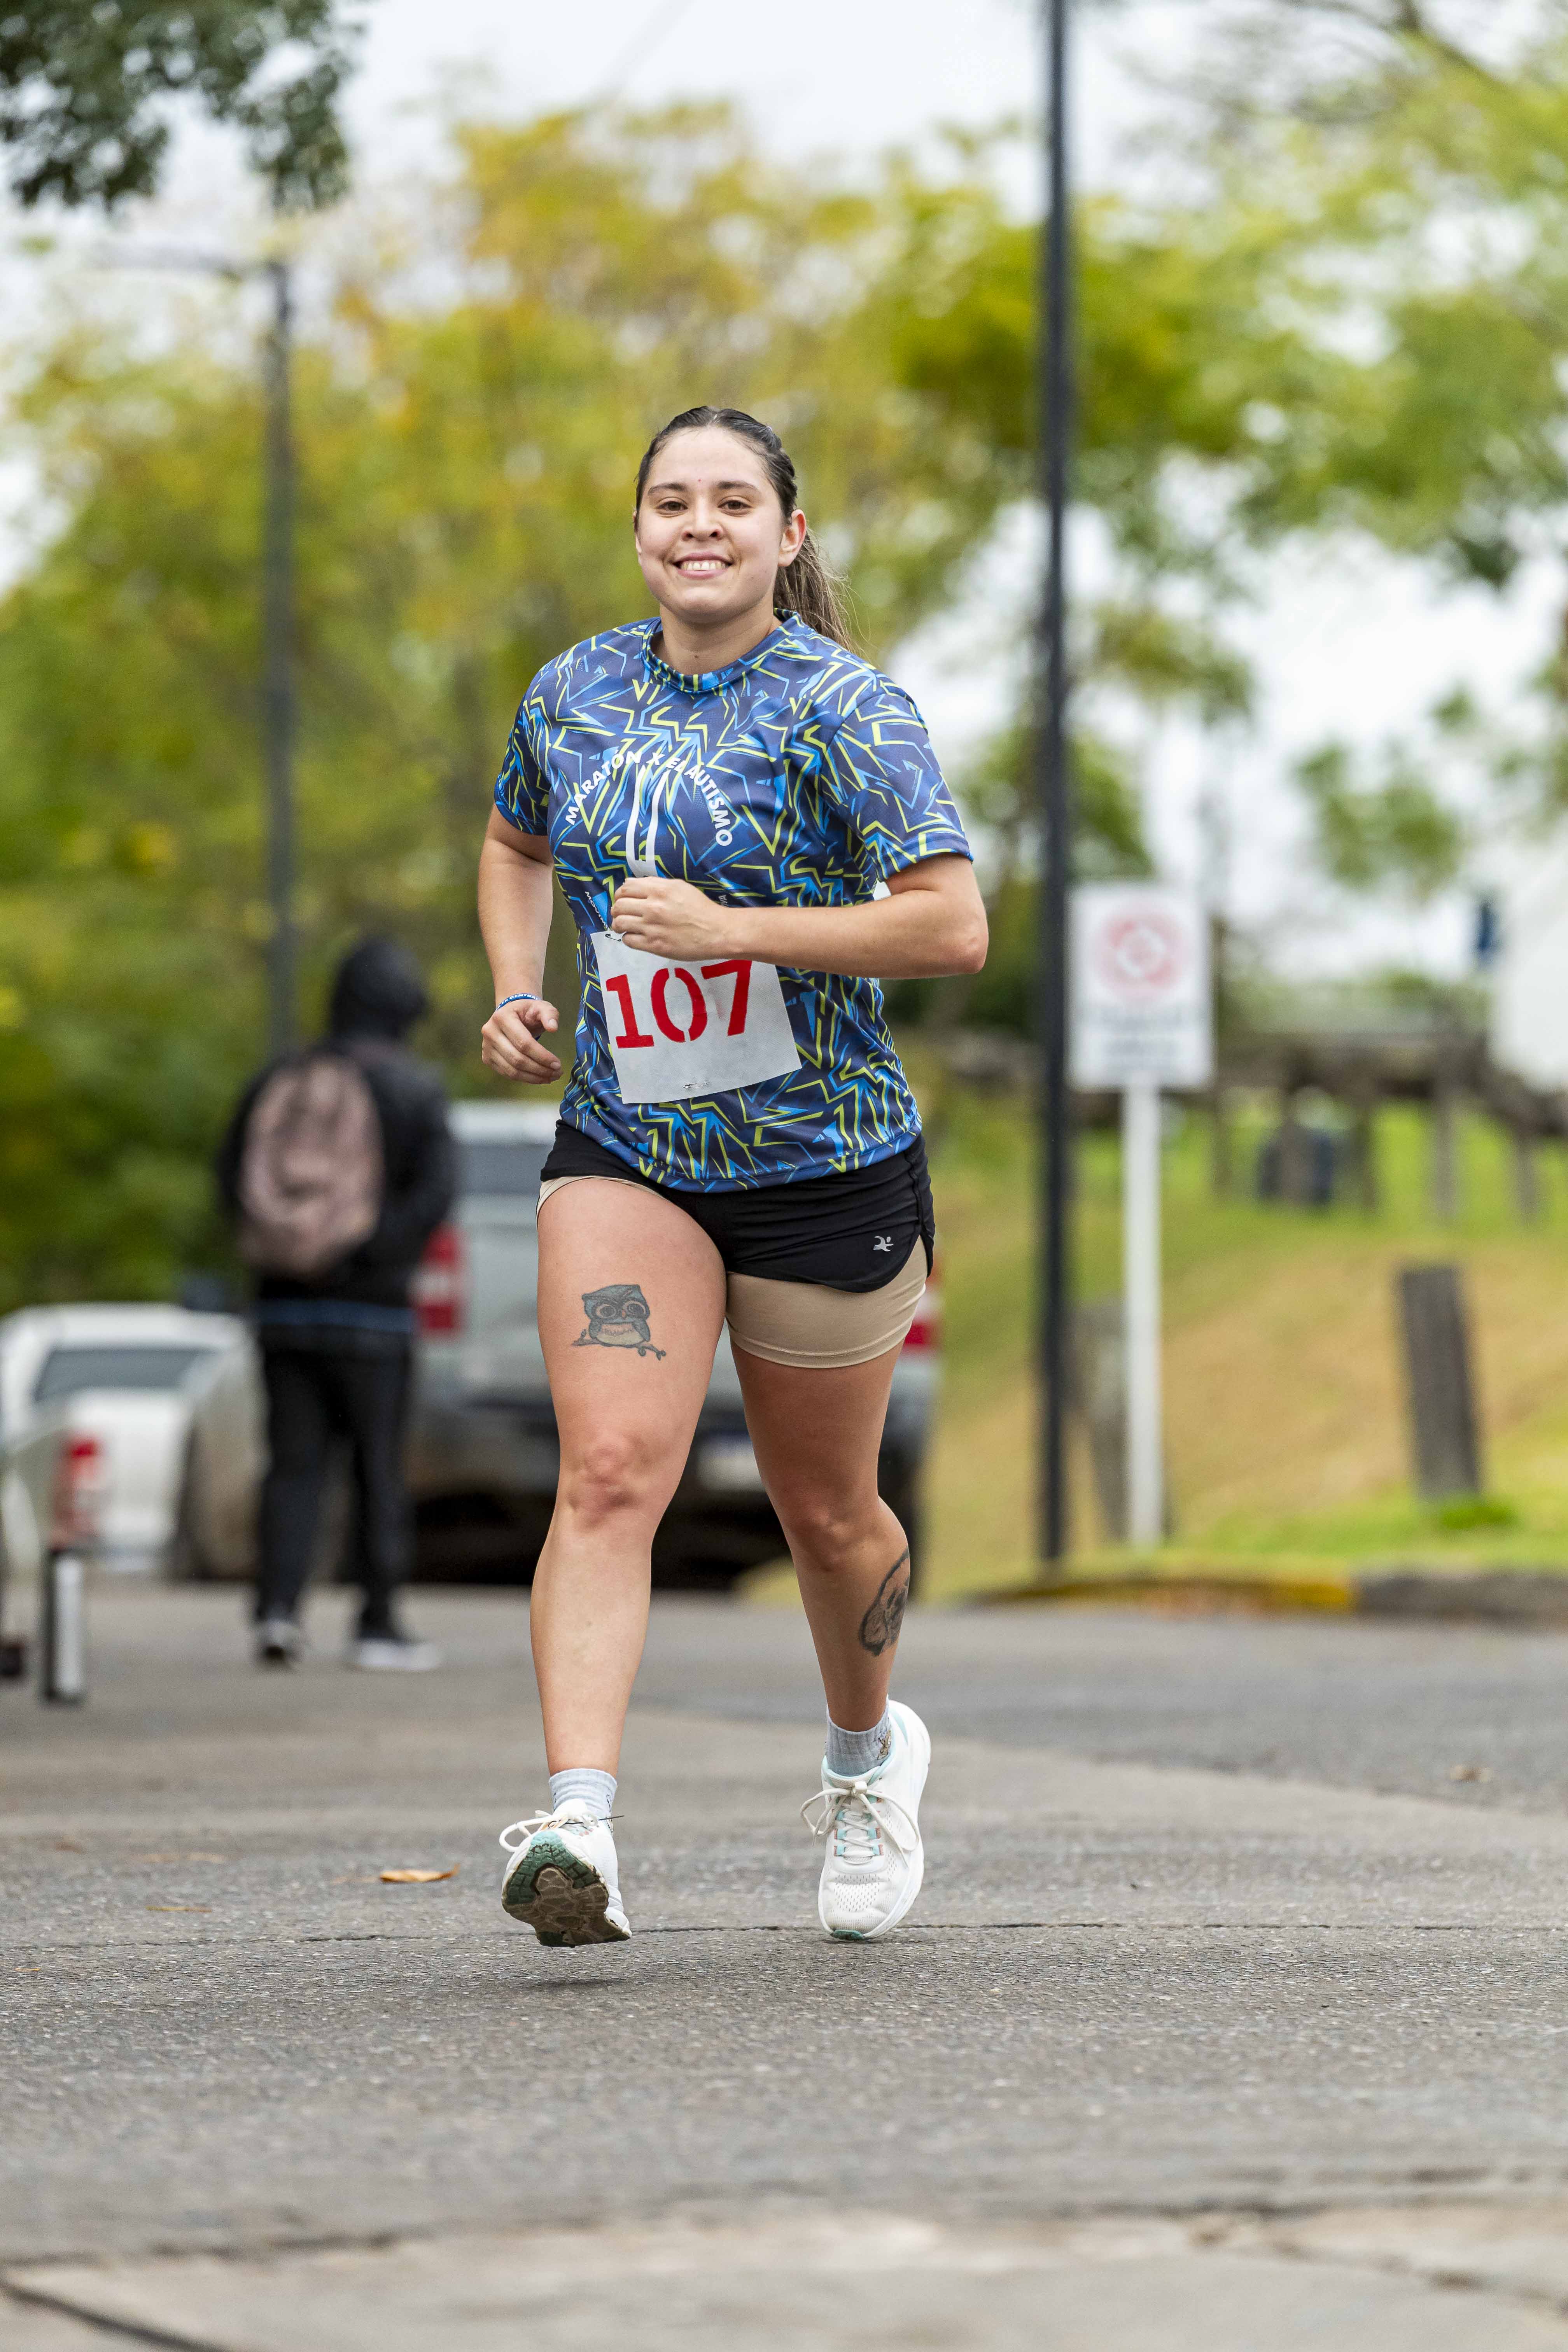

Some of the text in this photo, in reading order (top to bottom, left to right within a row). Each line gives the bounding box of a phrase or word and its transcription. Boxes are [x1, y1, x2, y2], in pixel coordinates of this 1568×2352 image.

[565, 749, 642, 825] MARATÓN
[665, 757, 686, 772] EL
[684, 765, 733, 846] AUTISMO
[606, 959, 752, 1048] 107
